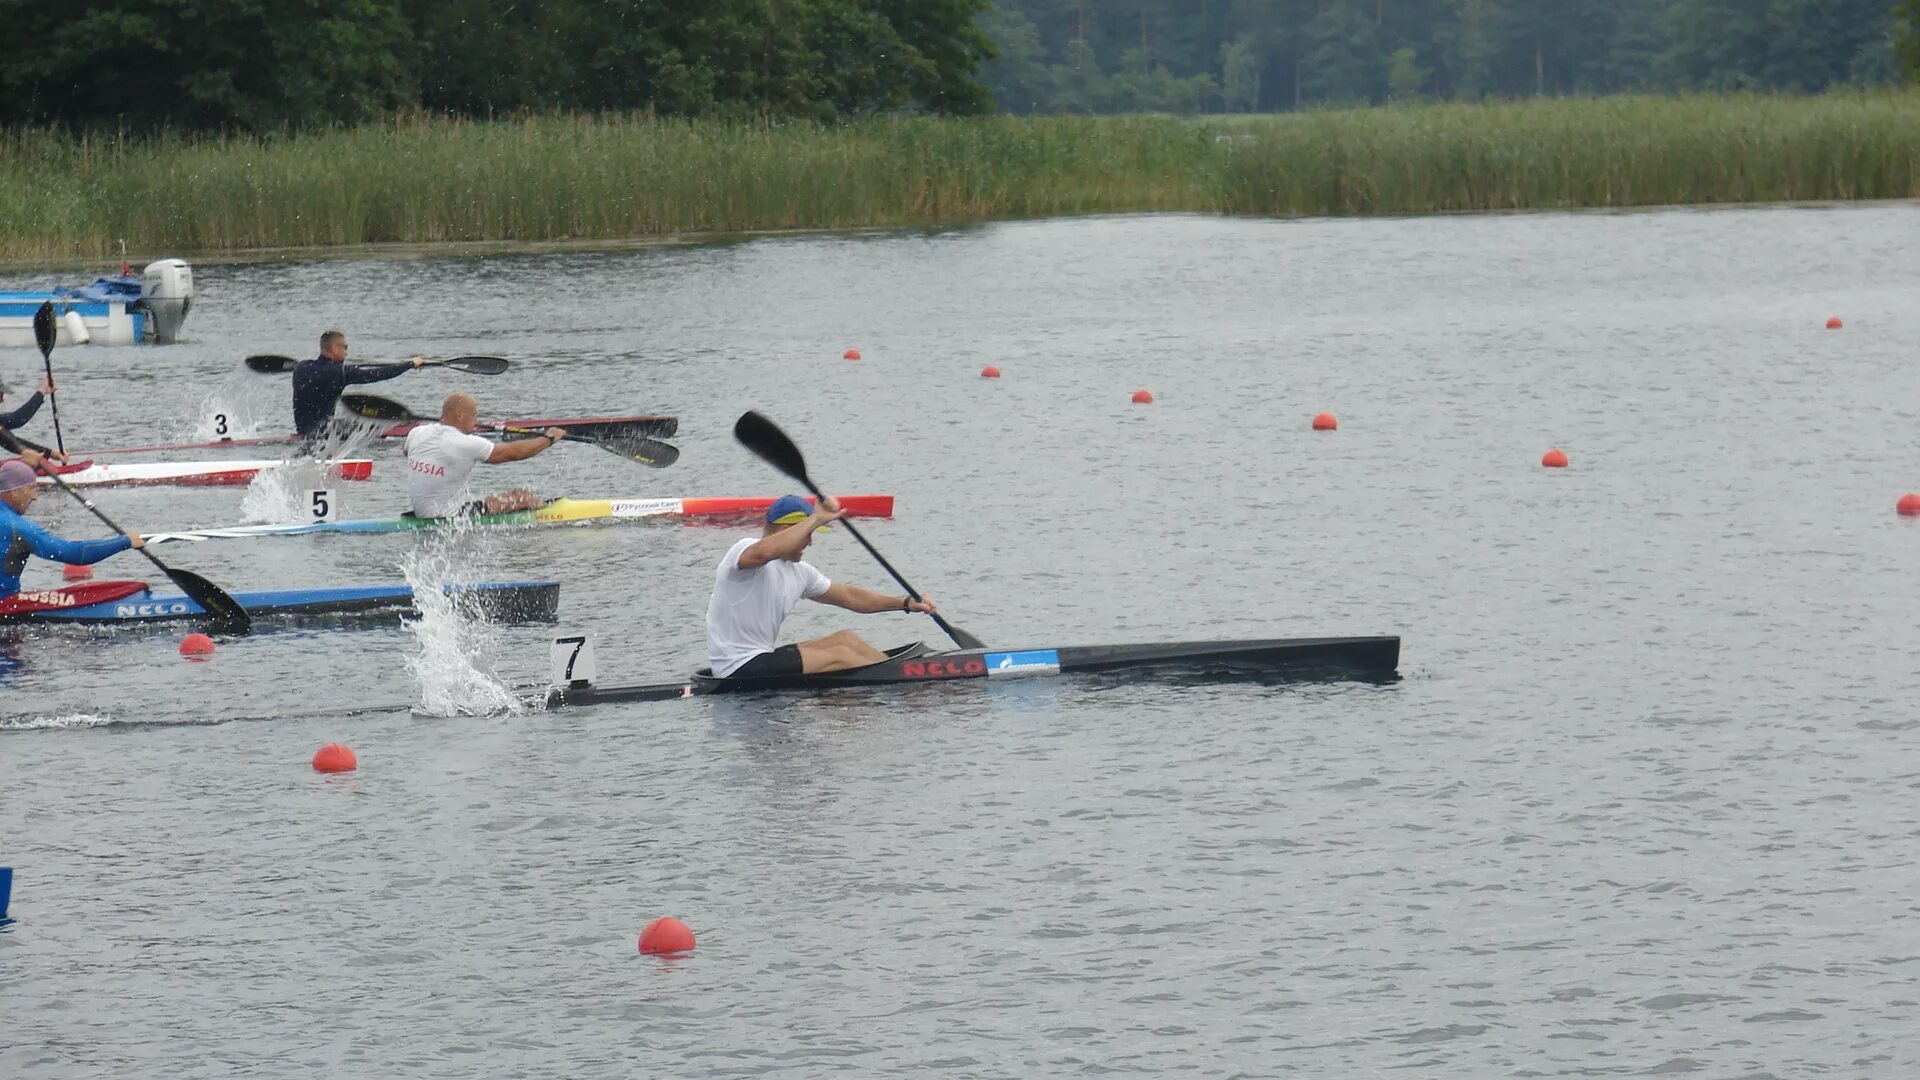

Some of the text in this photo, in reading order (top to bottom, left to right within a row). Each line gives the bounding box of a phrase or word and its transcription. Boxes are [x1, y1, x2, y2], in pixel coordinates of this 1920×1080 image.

[214, 413, 228, 435] 3
[312, 490, 329, 518] 5
[18, 591, 76, 606] RUSSIA
[115, 604, 187, 616] NELO
[556, 636, 586, 680] 7
[902, 659, 984, 677] NELO
